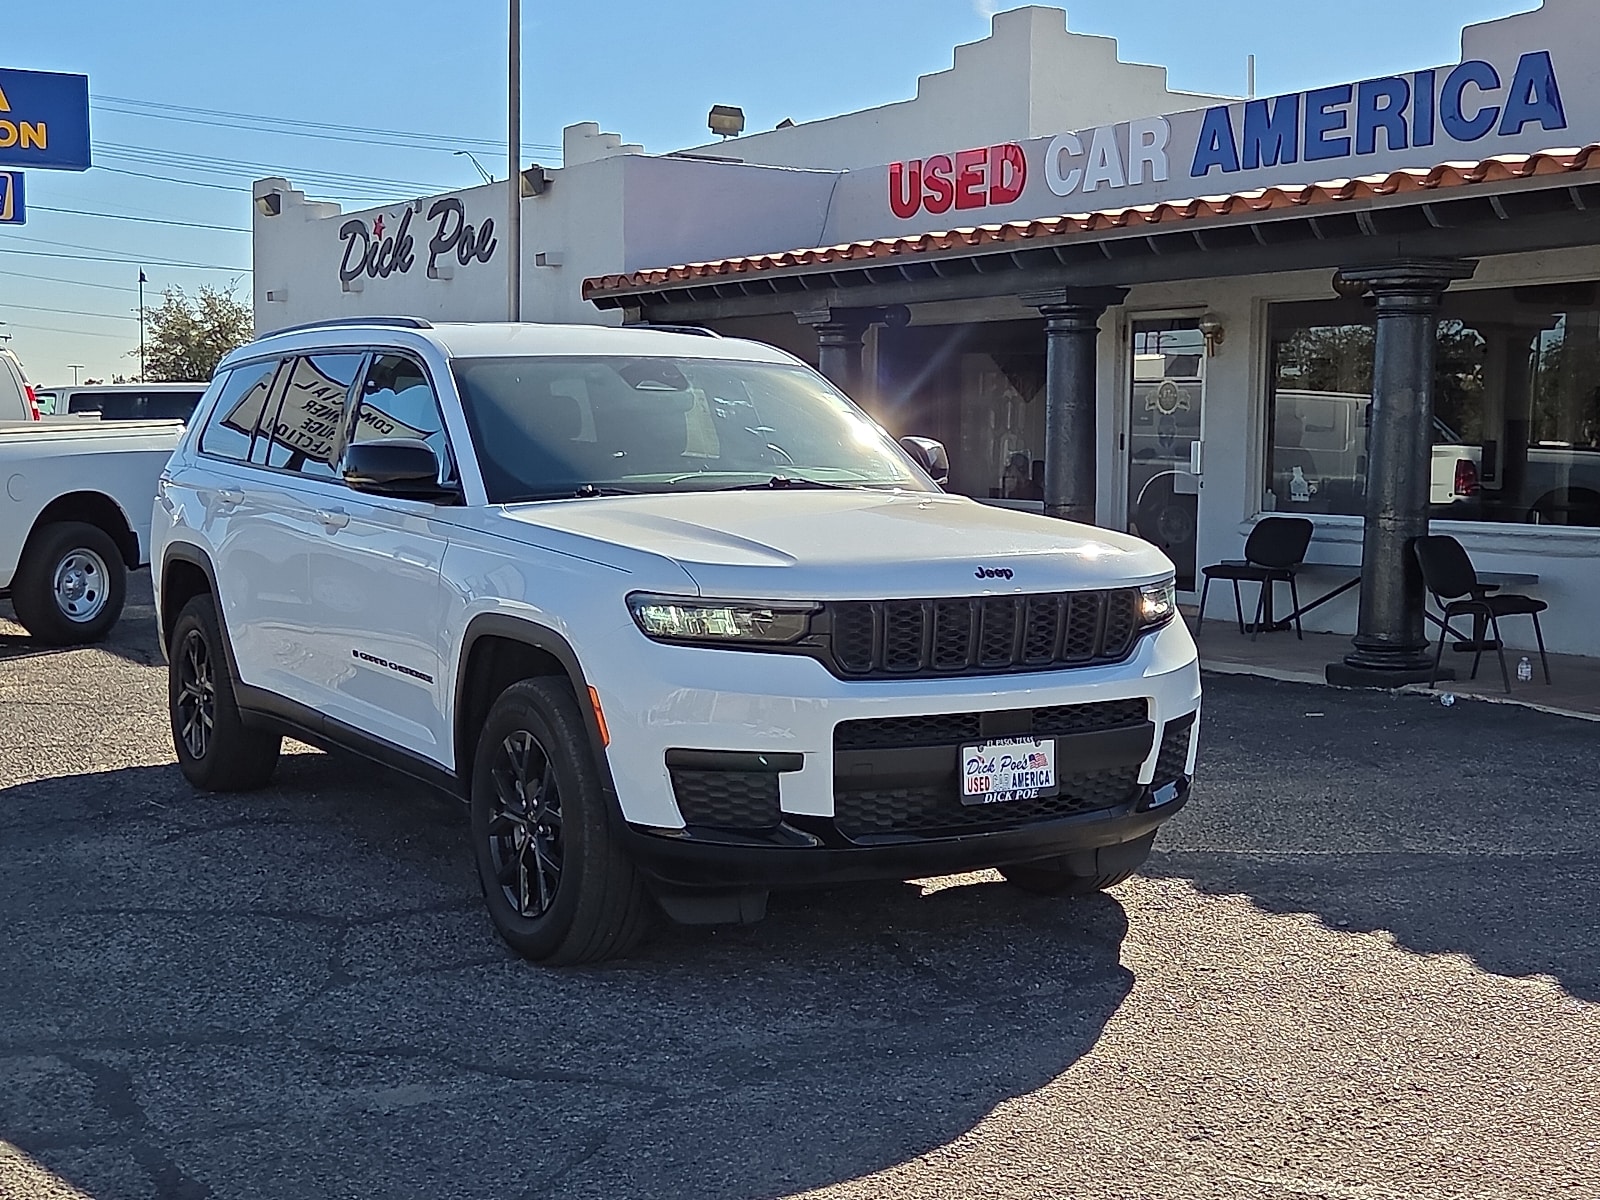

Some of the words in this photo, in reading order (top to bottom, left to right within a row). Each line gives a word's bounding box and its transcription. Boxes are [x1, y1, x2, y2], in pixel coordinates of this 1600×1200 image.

[889, 141, 1028, 219] USED
[1044, 114, 1169, 197] CAR
[1190, 50, 1568, 177] AMERICA
[340, 207, 415, 282] Dick
[427, 198, 498, 279] Poe
[974, 566, 1014, 580] Jeep
[967, 756, 996, 776] Dick
[1000, 753, 1028, 773] Poe's
[967, 776, 990, 793] USED
[1011, 770, 1050, 789] AMERICA
[983, 791, 1013, 804] DICK
[1014, 788, 1040, 800] POE
